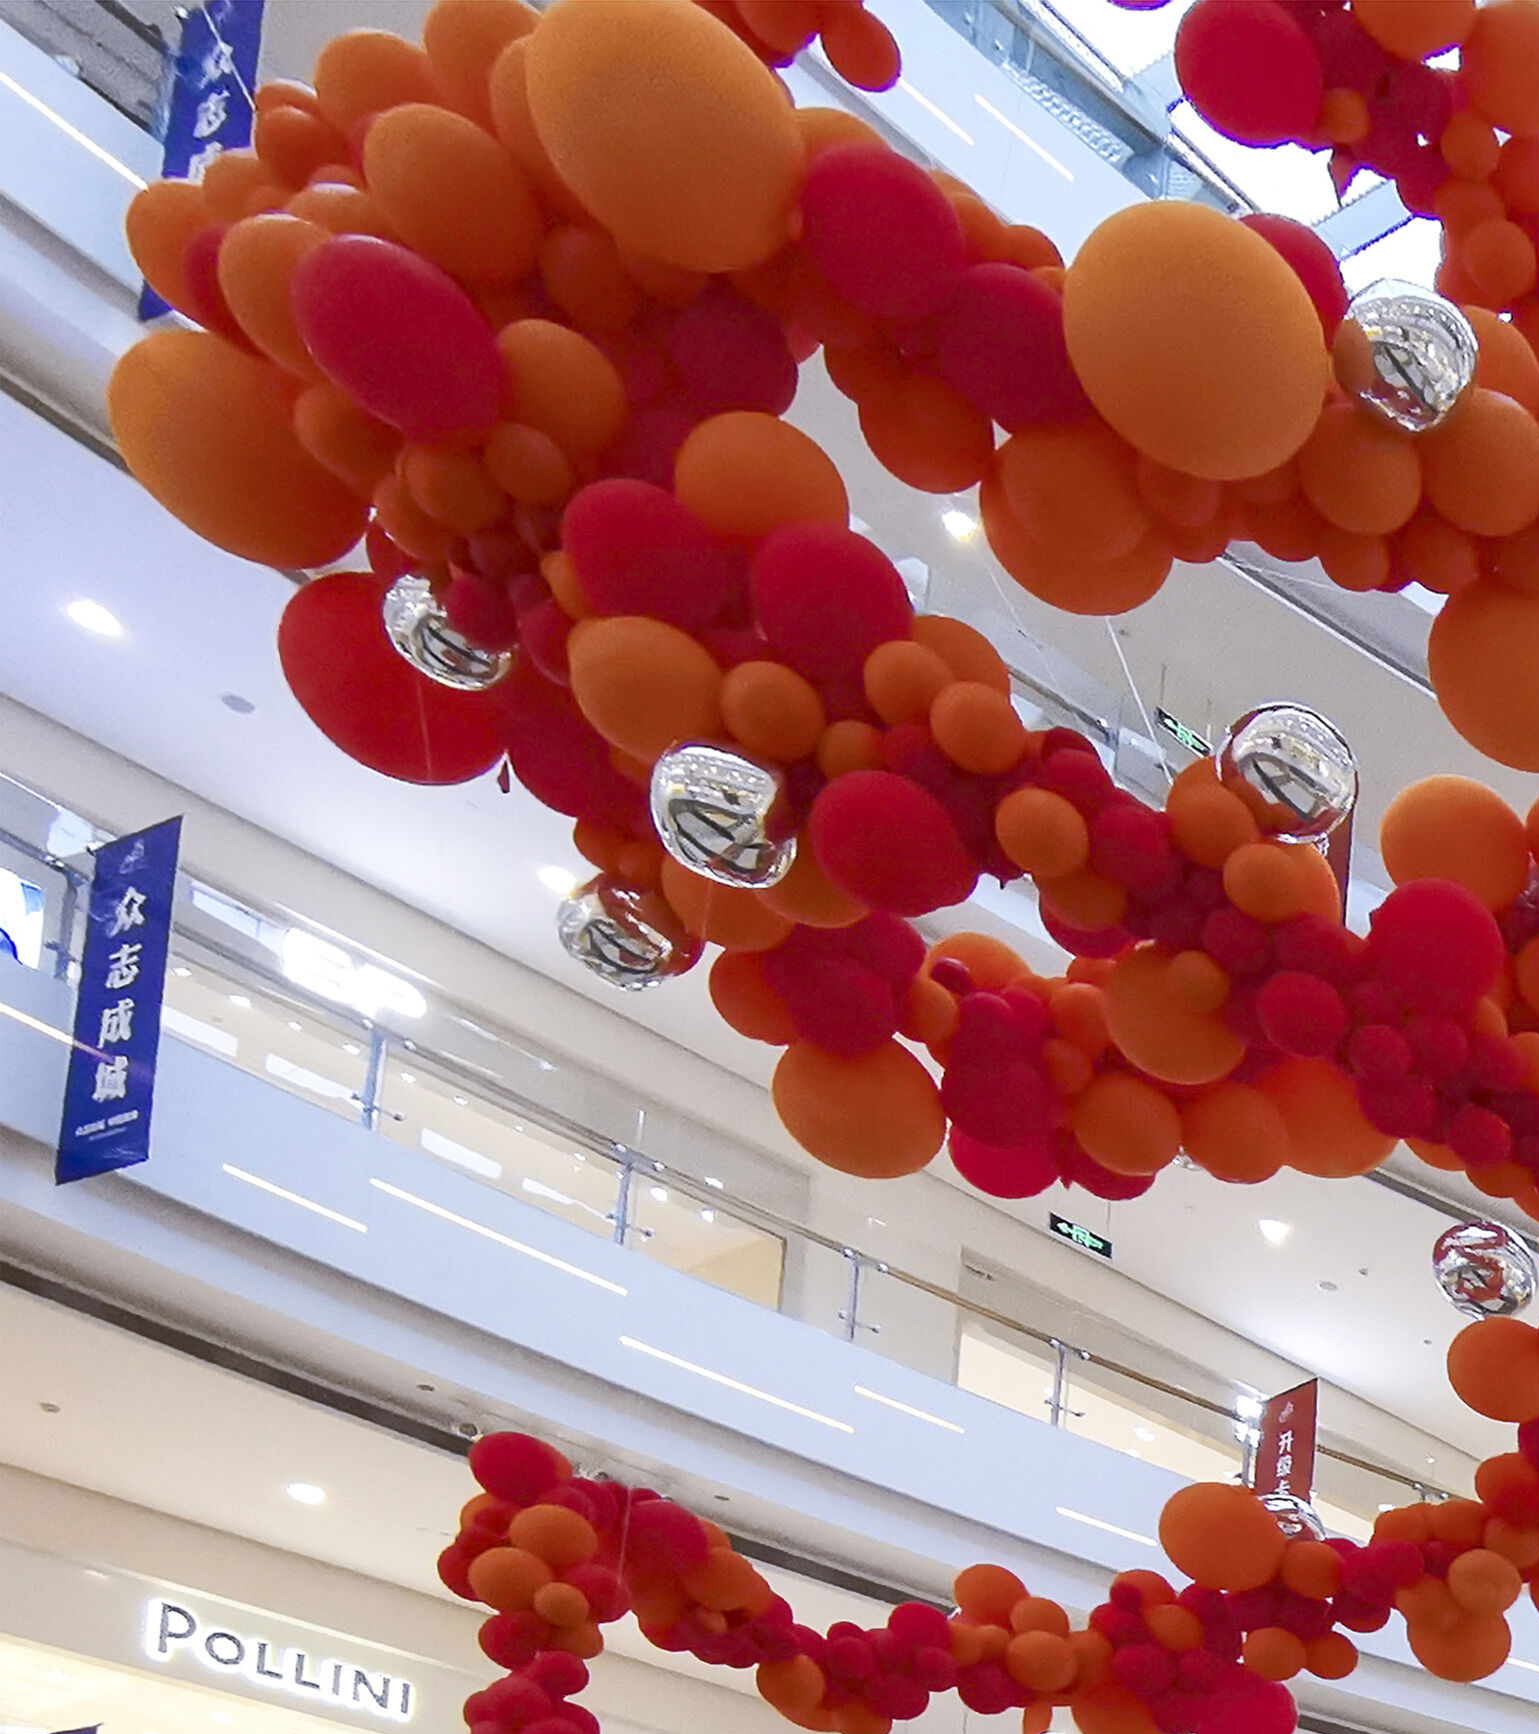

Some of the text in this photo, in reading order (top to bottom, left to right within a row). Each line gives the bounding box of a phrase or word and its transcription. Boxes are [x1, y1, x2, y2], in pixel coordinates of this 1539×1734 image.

[92, 886, 147, 1103] 众志成城
[157, 1601, 411, 1715] POLLINI
